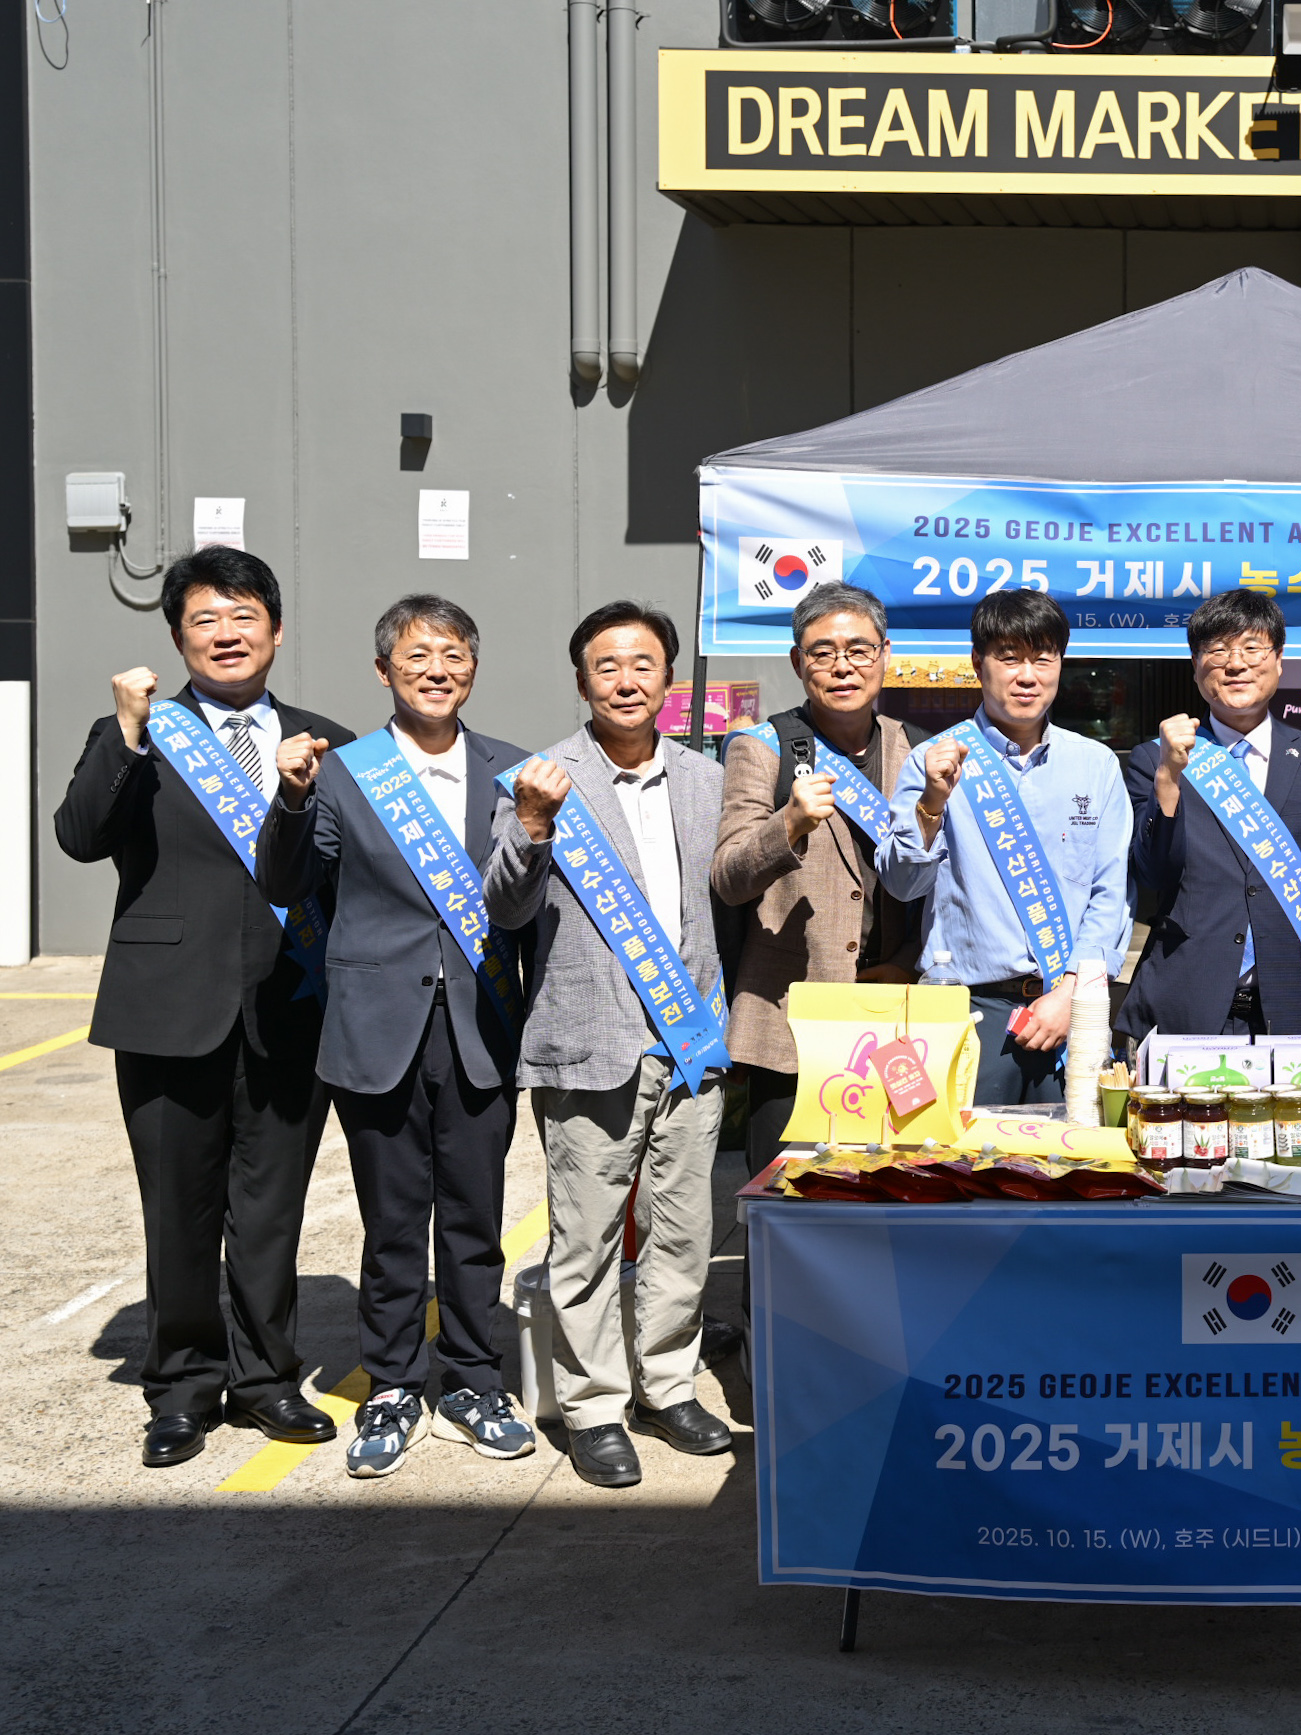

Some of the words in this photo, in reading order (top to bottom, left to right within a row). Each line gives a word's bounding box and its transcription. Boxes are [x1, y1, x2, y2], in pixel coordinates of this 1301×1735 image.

[727, 86, 988, 158] DREAM
[913, 515, 991, 538] 2025
[1005, 519, 1094, 543] GEOJE
[1107, 521, 1271, 544] EXCELLENT
[912, 556, 1050, 597] 2025
[1075, 559, 1211, 600] 거제시
[1076, 613, 1101, 628] 15.
[1109, 613, 1150, 629] (W),
[149, 714, 208, 773] 거제시
[171, 711, 202, 739] GEOJE
[200, 738, 250, 798] EXCELLENT
[933, 725, 971, 743] 2025
[371, 770, 412, 800] 2025
[825, 752, 880, 806] EXCELLENT
[1191, 750, 1227, 780] 2025
[384, 796, 439, 868] 거제시
[966, 736, 993, 767] GEOJE
[989, 769, 1028, 837] EXCELLENT
[1023, 844, 1056, 912] AGRI-FOOD
[1205, 774, 1260, 838] 거제시
[1224, 767, 1252, 800] GEOJE
[1251, 801, 1296, 864] EXCELLENT
[407, 790, 435, 827] GEOJE
[431, 831, 479, 895] EXCELLENT
[982, 808, 1048, 925] 농수산식품
[563, 846, 647, 962] 농수산식품
[635, 959, 684, 1027] 홍보전
[566, 808, 615, 874] EXCELLENT
[613, 878, 658, 943] AGRI-FOOD
[654, 946, 697, 1014] PROMOTION
[944, 1373, 1026, 1400] 2025
[1039, 1373, 1132, 1399] GEOJE
[934, 1423, 1081, 1472] 2025
[1104, 1421, 1254, 1471] 거제시
[977, 1527, 1039, 1548] 2025.
[1047, 1528, 1075, 1549] 10.
[1083, 1529, 1112, 1550] 15.
[1120, 1529, 1167, 1550] (W),
[1174, 1528, 1215, 1549] 호주
[1222, 1526, 1301, 1550] (시드니)
